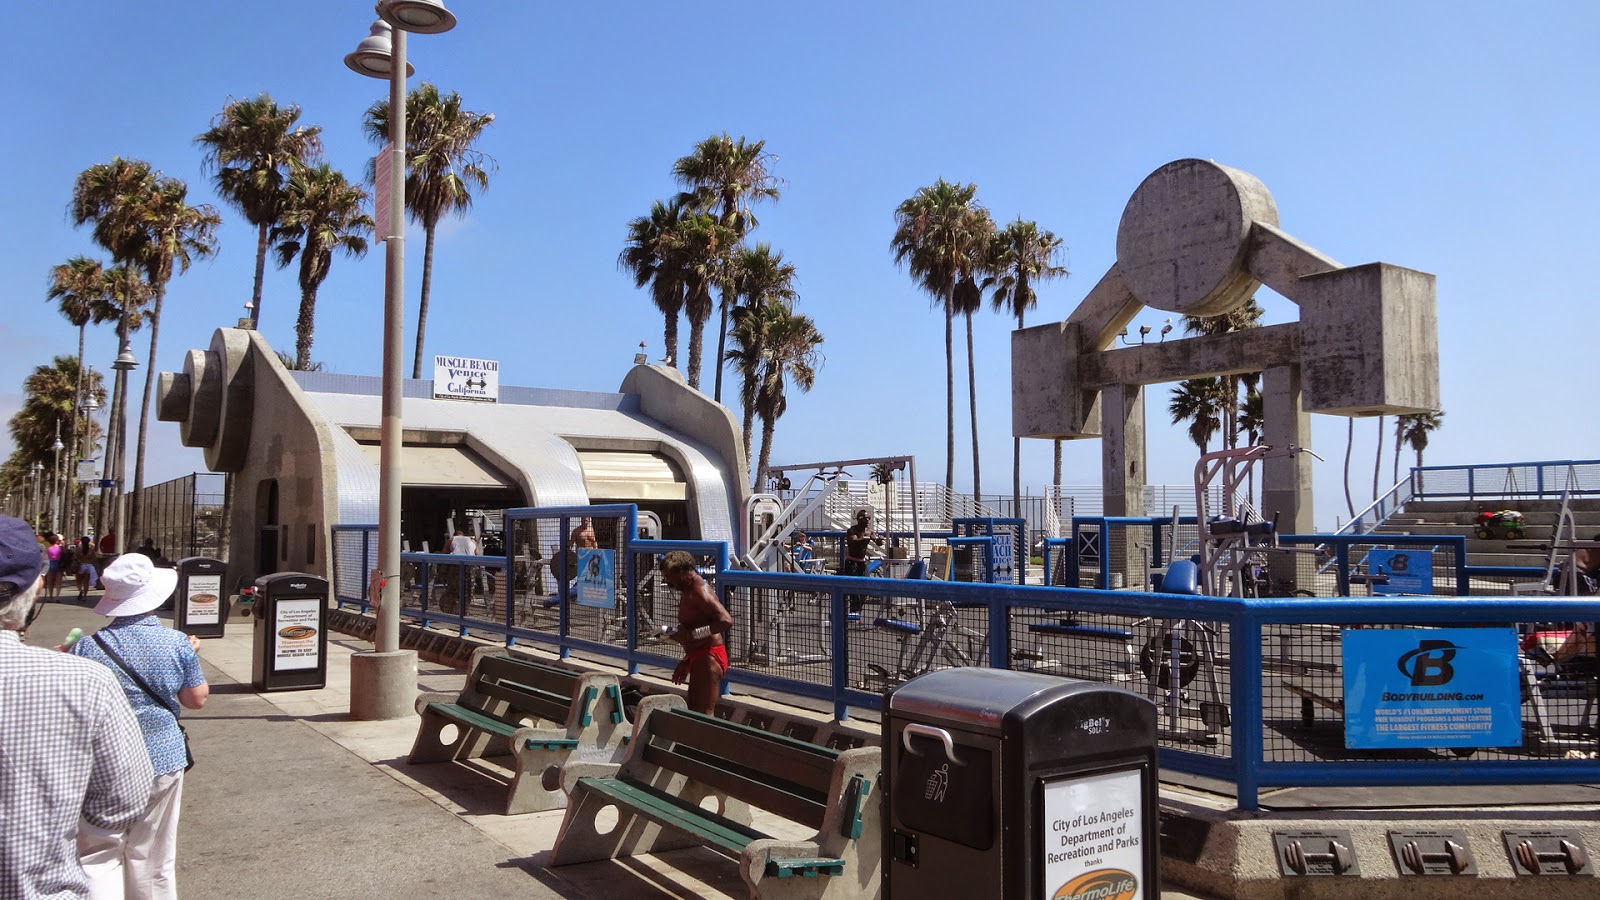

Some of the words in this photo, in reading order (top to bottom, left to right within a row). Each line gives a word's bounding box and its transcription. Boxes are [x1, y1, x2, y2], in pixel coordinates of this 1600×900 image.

[436, 357, 468, 368] MUSCLE
[469, 360, 498, 372] BEACH
[448, 369, 486, 379] Venice
[448, 382, 486, 395] California
[1407, 640, 1458, 687] B
[1052, 818, 1071, 833] City
[1072, 817, 1082, 827] of
[1083, 814, 1098, 826] Los
[1100, 806, 1134, 824] Angeles
[1061, 826, 1114, 848] Department
[1116, 822, 1126, 836] of
[1047, 844, 1096, 865] Recreation
[1098, 840, 1114, 853] and
[1116, 836, 1140, 850] Parks
[1084, 856, 1103, 868] thanks
